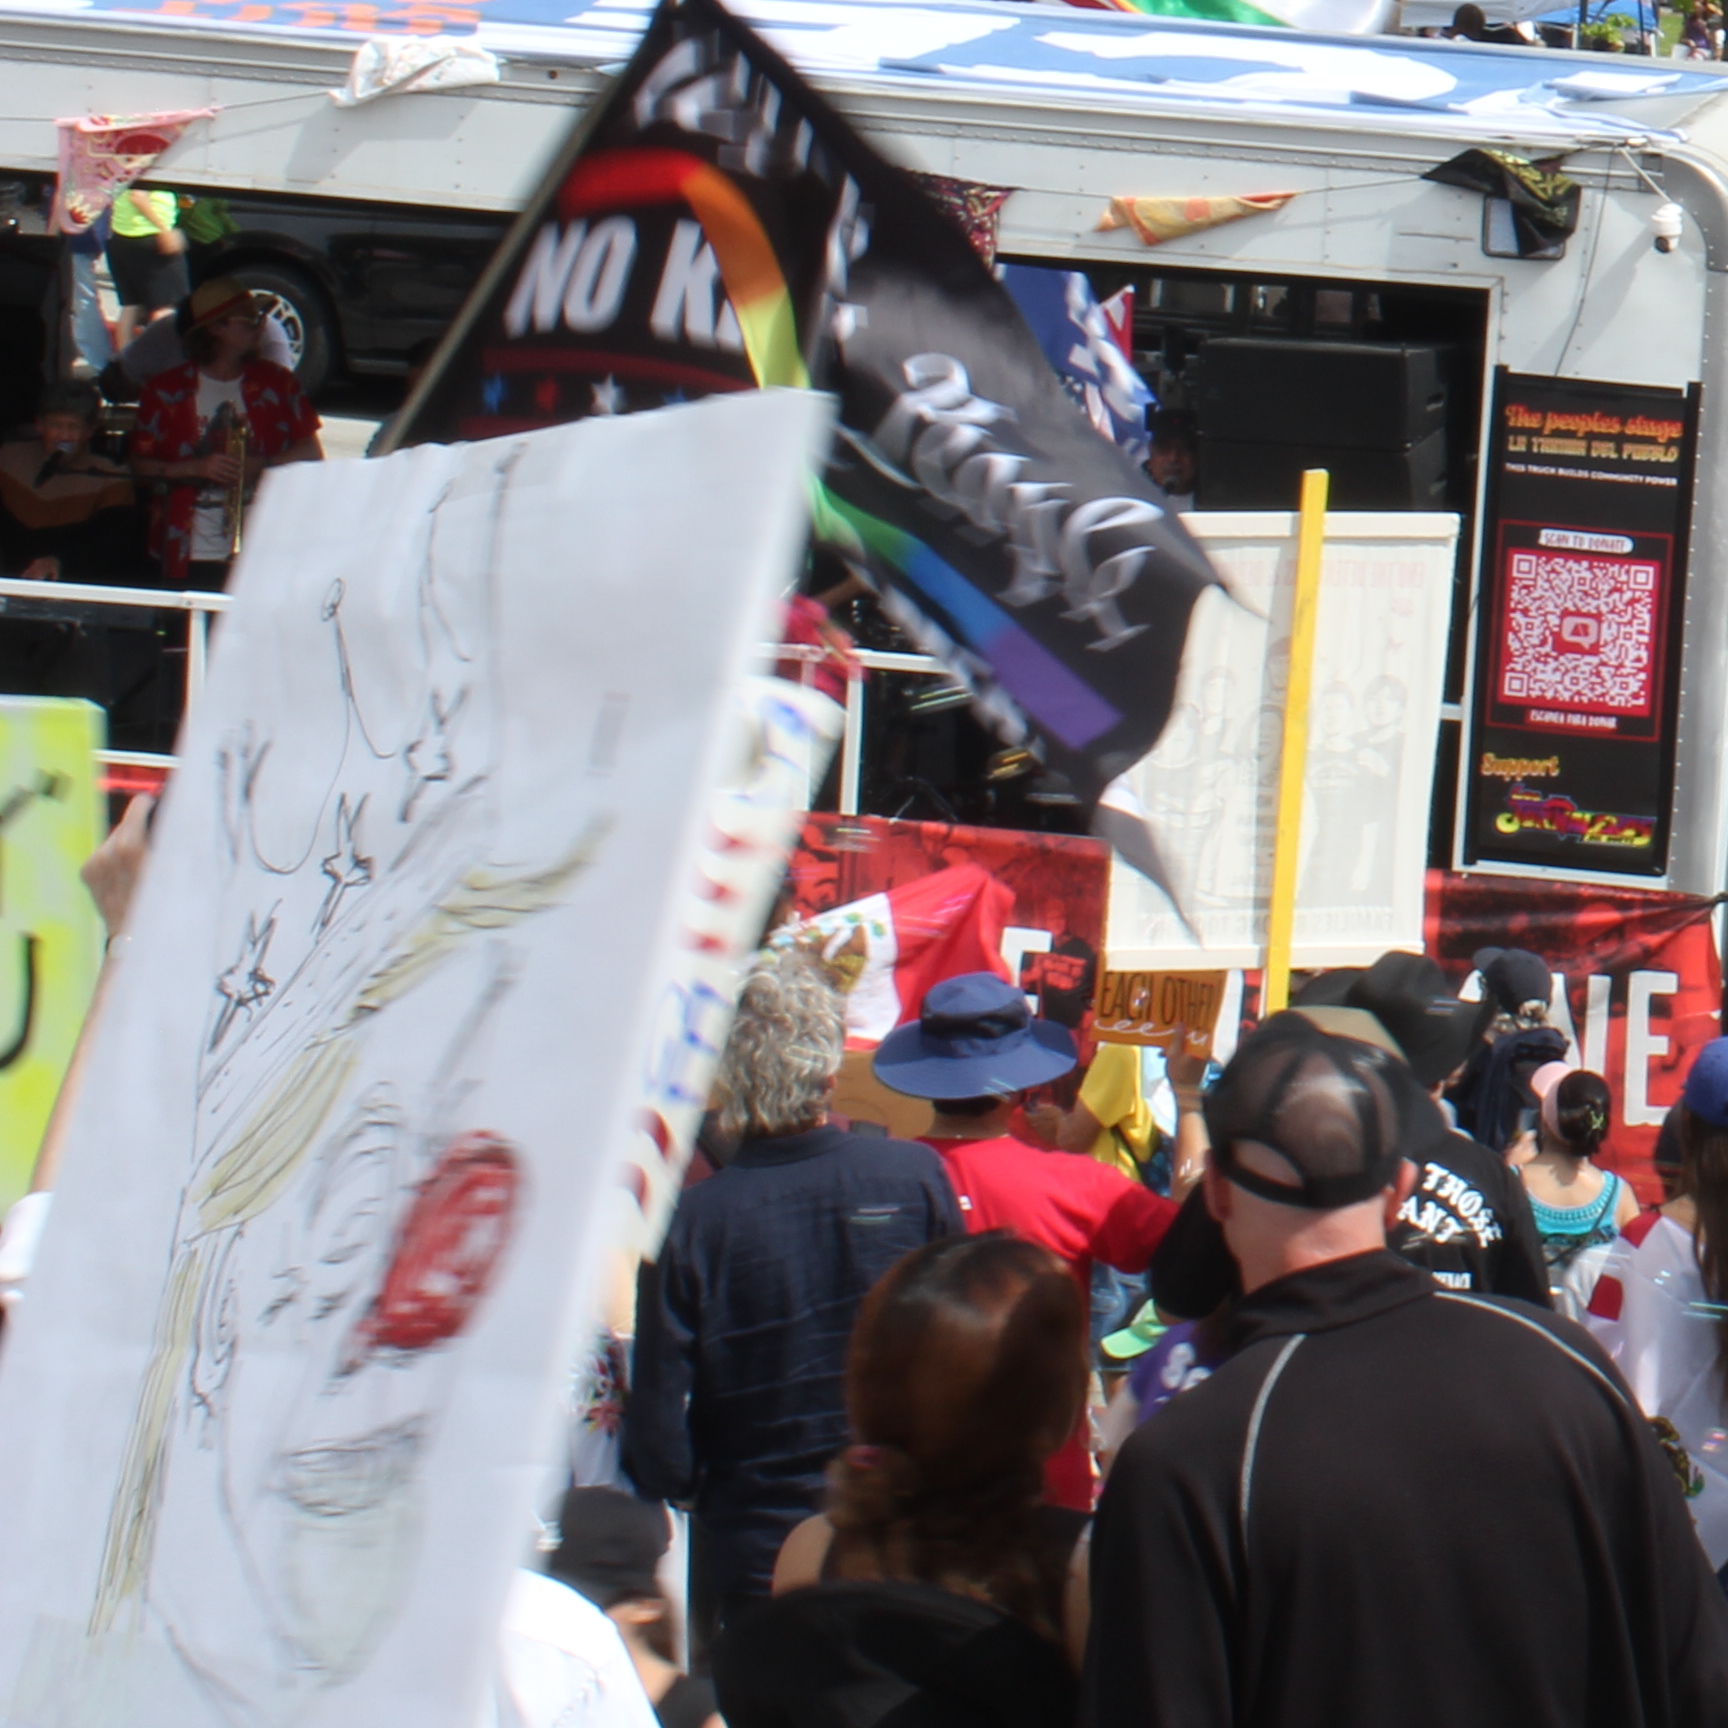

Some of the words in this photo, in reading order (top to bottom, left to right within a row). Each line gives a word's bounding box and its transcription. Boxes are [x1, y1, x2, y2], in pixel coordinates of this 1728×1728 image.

[505, 217, 638, 340] NO
[1505, 403, 1542, 428] The
[1543, 411, 1621, 438] peoples
[1624, 415, 1684, 444] stage
[1621, 441, 1681, 463] PUEBLO
[1527, 463, 1557, 475] TRUCK
[1558, 467, 1589, 479] BUILDS
[1590, 470, 1644, 484] COMMUNITY
[1645, 475, 1678, 487] POWER
[1544, 530, 1570, 547] SCAN
[1572, 534, 1585, 547] TO
[1588, 535, 1627, 552] DONATE
[1481, 752, 1560, 782] Support
[1101, 972, 1153, 1016] EACH
[1422, 1161, 1503, 1249] THOSE
